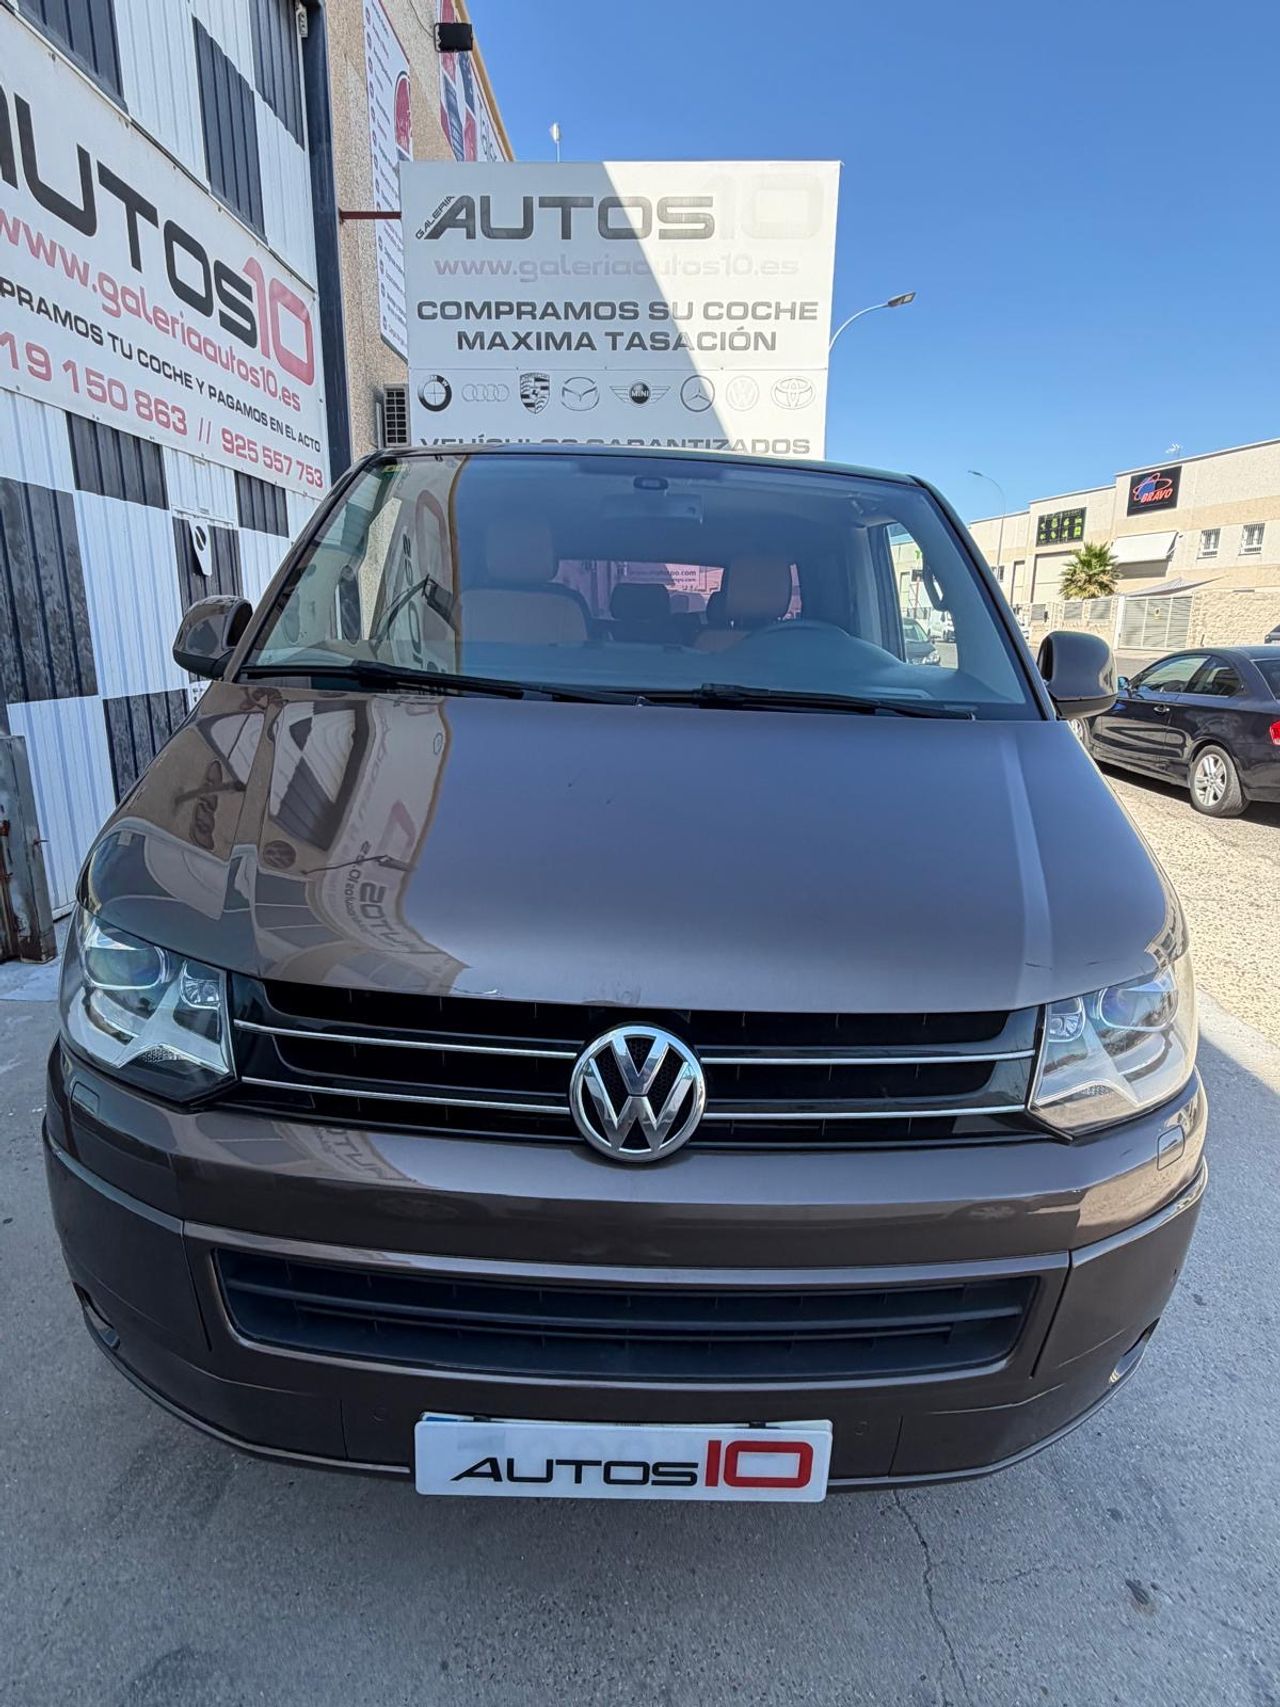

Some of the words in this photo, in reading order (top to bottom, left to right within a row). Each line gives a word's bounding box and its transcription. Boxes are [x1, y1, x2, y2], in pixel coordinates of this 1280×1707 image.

[0, 83, 315, 386] UTOS10
[415, 194, 456, 241] GALERIA
[434, 253, 799, 283] www.galeriaautos10.es
[417, 300, 639, 321] COMPRAMOS
[648, 301, 694, 321] SU
[702, 301, 818, 321] COCHE
[457, 331, 597, 351] MAXIMA
[605, 326, 777, 351] TASACIÓN
[107, 332, 133, 360] TU
[137, 348, 193, 390] COCHE
[196, 377, 205, 395] Y
[208, 385, 268, 426] PAGAMOS
[270, 416, 284, 435] EN
[285, 425, 296, 442] EL
[298, 433, 321, 453] ACTO
[62, 359, 129, 412] 150
[134, 389, 188, 436] 863
[221, 427, 259, 464] 925
[262, 446, 293, 476] 557
[296, 459, 323, 489] 753
[1140, 488, 1173, 503] BRAVO
[450, 1440, 814, 1490] AUTOS10
